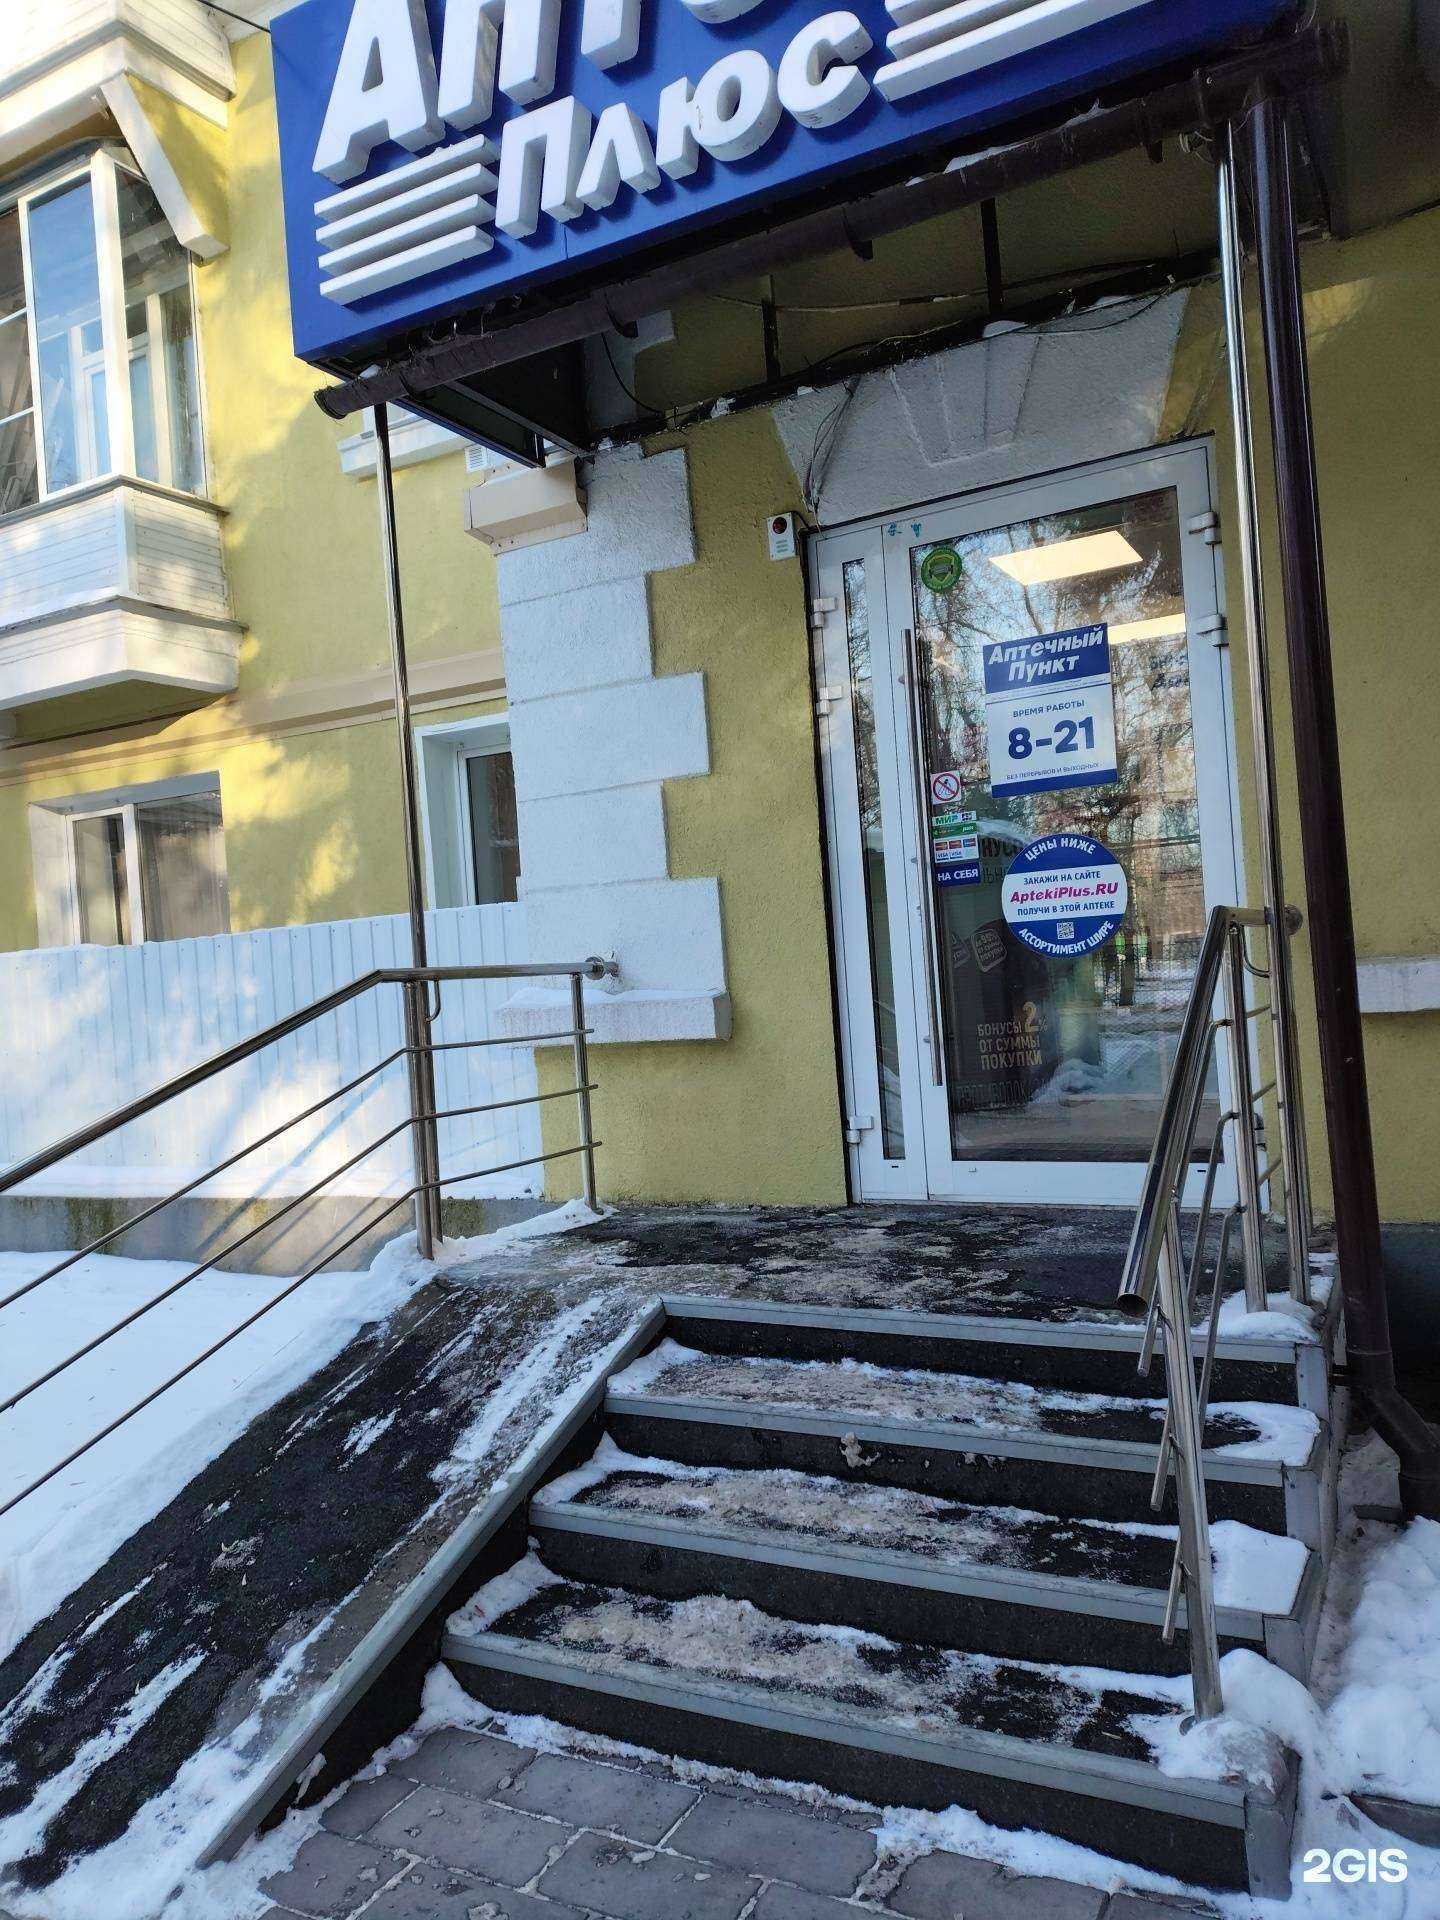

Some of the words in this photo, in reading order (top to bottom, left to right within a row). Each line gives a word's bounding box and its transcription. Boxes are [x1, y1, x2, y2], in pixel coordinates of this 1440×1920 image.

[988, 626, 1103, 664] Аптечный
[1009, 656, 1079, 682] Пункт
[1013, 707, 1043, 717] ВРЕМЯ
[1046, 700, 1085, 713] РАБОТЫ
[935, 815, 958, 825] МИР
[1025, 839, 1057, 861] ЦЕНЫ
[1061, 838, 1097, 854] НИЖЕ
[938, 873, 951, 881] НА
[954, 869, 979, 880] СЕБЯ
[1024, 875, 1058, 885] ЗАКАЖИ
[1061, 873, 1072, 881] НА
[1075, 870, 1101, 880] САЙТЕ
[1010, 882, 1118, 903] AptekiPlus.RU
[1017, 906, 1050, 916] ПОЛУЧИ
[1060, 903, 1081, 912] ЭТОЙ
[1083, 900, 1115, 911] АПТЕКЕ
[1019, 928, 1087, 955] АССОРТИМЕНТ
[1087, 920, 1114, 947] ШИРЕ
[977, 1020, 1022, 1037] БОНУСЫ
[980, 1038, 993, 1053] ОТ
[996, 1035, 1040, 1052] СУММЫ
[981, 1050, 1043, 1071] ПОКУПКИ
